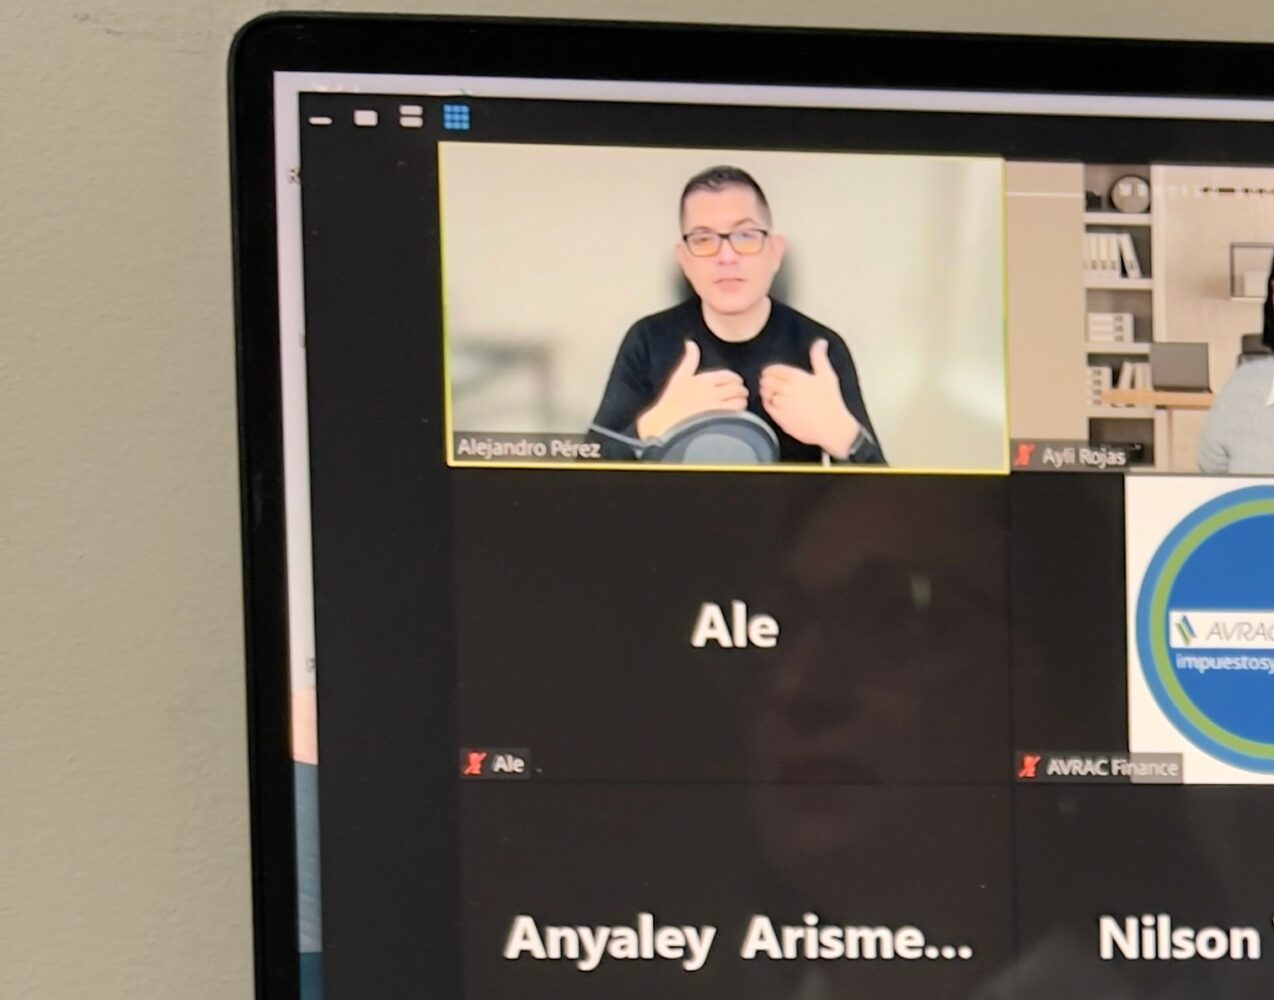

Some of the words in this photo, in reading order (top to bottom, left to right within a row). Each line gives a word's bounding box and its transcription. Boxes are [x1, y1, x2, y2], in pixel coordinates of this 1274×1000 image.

[457, 437, 547, 460] Alejandro
[550, 438, 602, 459] Pérez
[1078, 447, 1127, 468] Rojas
[690, 600, 780, 649] Ale
[492, 754, 526, 773] Ale
[1046, 757, 1109, 777] AVRAC
[1111, 757, 1179, 777] Finance
[504, 912, 716, 971] Anyaley
[740, 912, 974, 960] Arisme...
[1099, 913, 1261, 960] Nilson
